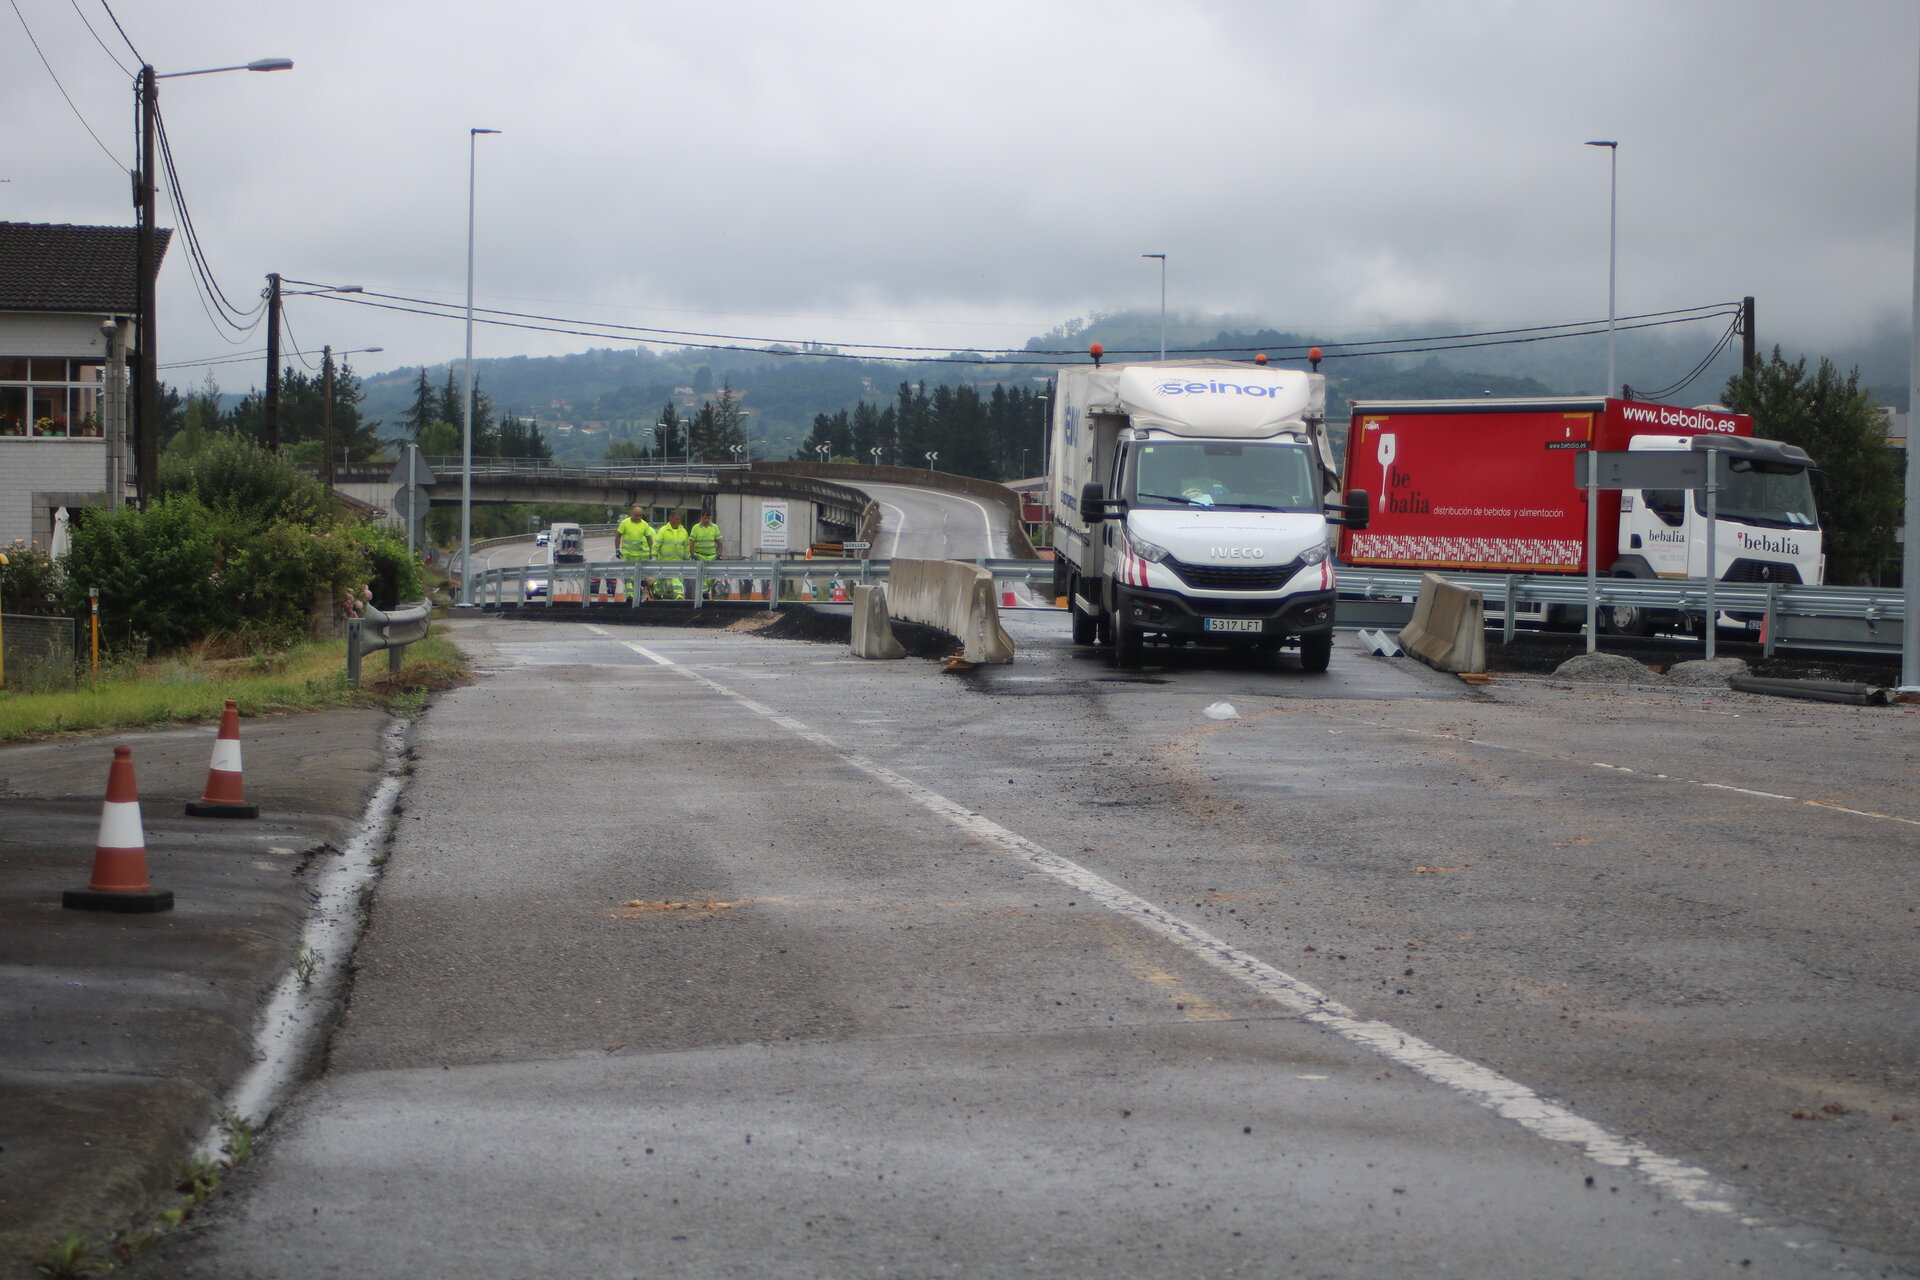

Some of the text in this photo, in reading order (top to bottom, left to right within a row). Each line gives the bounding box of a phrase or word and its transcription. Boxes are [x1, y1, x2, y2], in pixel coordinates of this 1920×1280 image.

[1162, 380, 1284, 398] seinor
[1623, 407, 1735, 433] www.bebalia.es
[1391, 466, 1411, 488] be
[1389, 491, 1430, 514] balia
[1473, 507, 1483, 516] de
[1483, 507, 1511, 517] bebidas
[1513, 509, 1518, 518] y
[1648, 529, 1685, 543] bebalia
[1744, 533, 1800, 555] bebalia
[1210, 547, 1264, 559] IVECO
[1212, 620, 1260, 631] 5317 LFT
